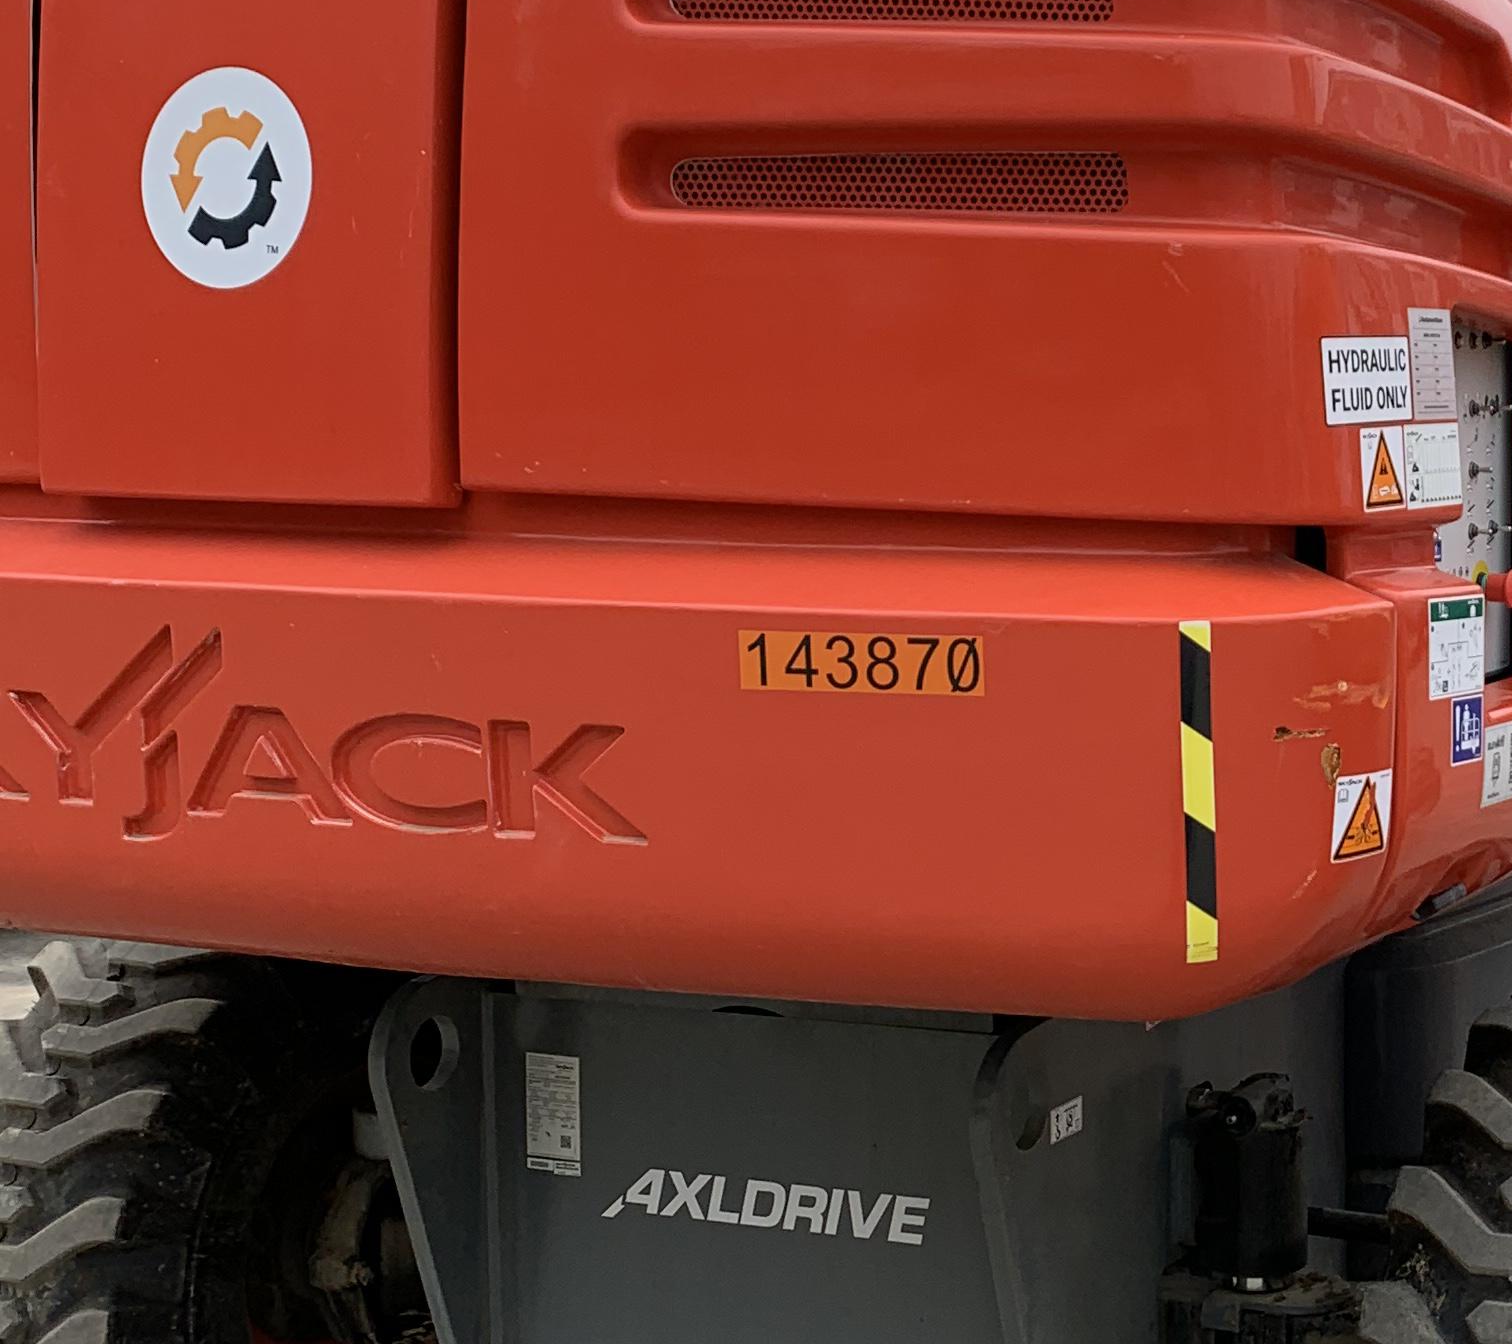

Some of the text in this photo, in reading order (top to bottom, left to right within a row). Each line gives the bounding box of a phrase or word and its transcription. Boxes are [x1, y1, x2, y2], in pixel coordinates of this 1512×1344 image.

[1328, 348, 1406, 374] HYDRAULIC
[1331, 385, 1408, 413] FLUID ONLY
[747, 632, 981, 693] 143870
[0, 623, 649, 846] YJACK
[601, 1167, 931, 1246] AXLDRIVE
